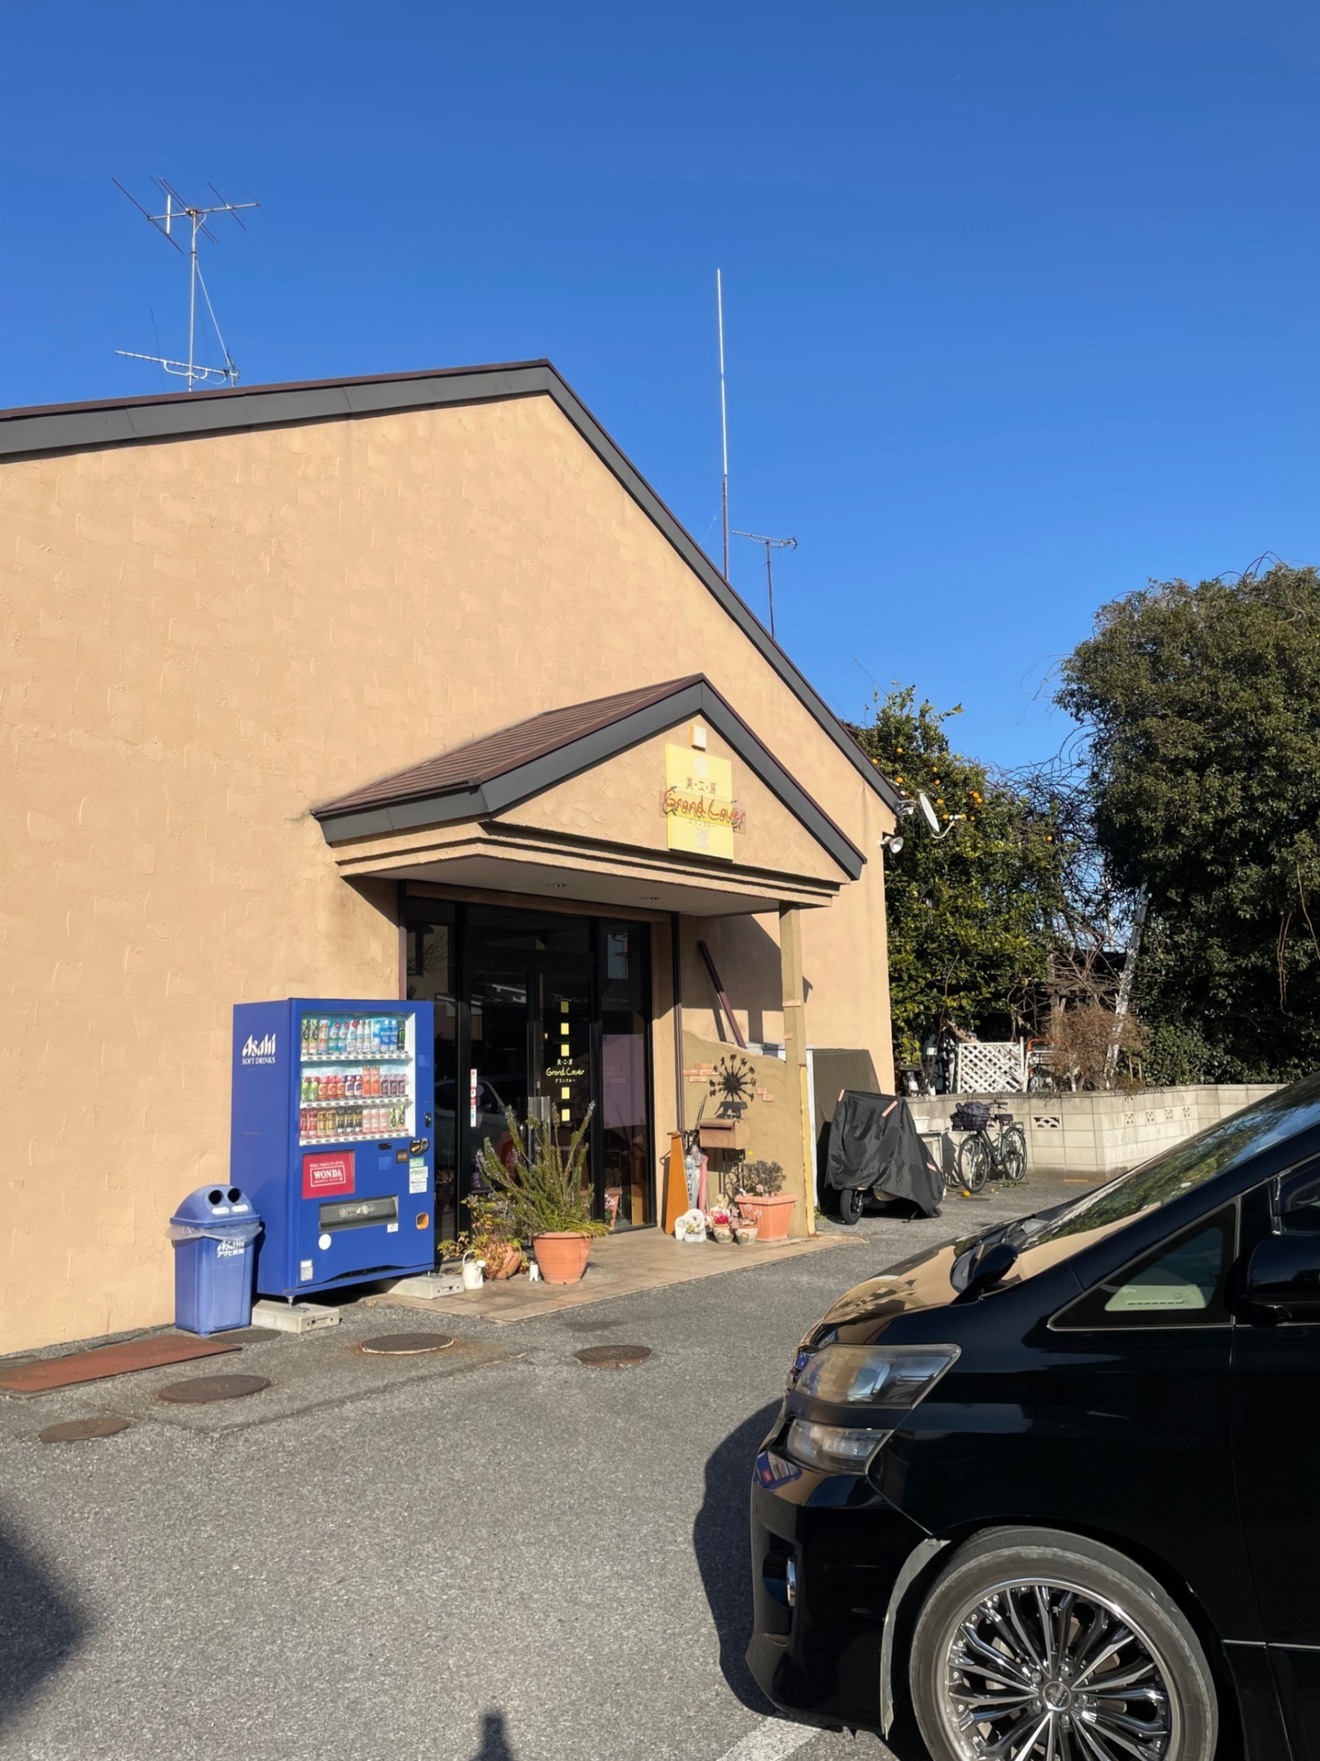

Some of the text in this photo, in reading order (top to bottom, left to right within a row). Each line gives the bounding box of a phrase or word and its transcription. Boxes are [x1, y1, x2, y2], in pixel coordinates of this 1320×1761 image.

[663, 786, 706, 816] Grand
[242, 1032, 276, 1057] Asahi
[242, 1056, 276, 1065] SOFT DRINKS
[313, 1168, 342, 1180] WONDA
